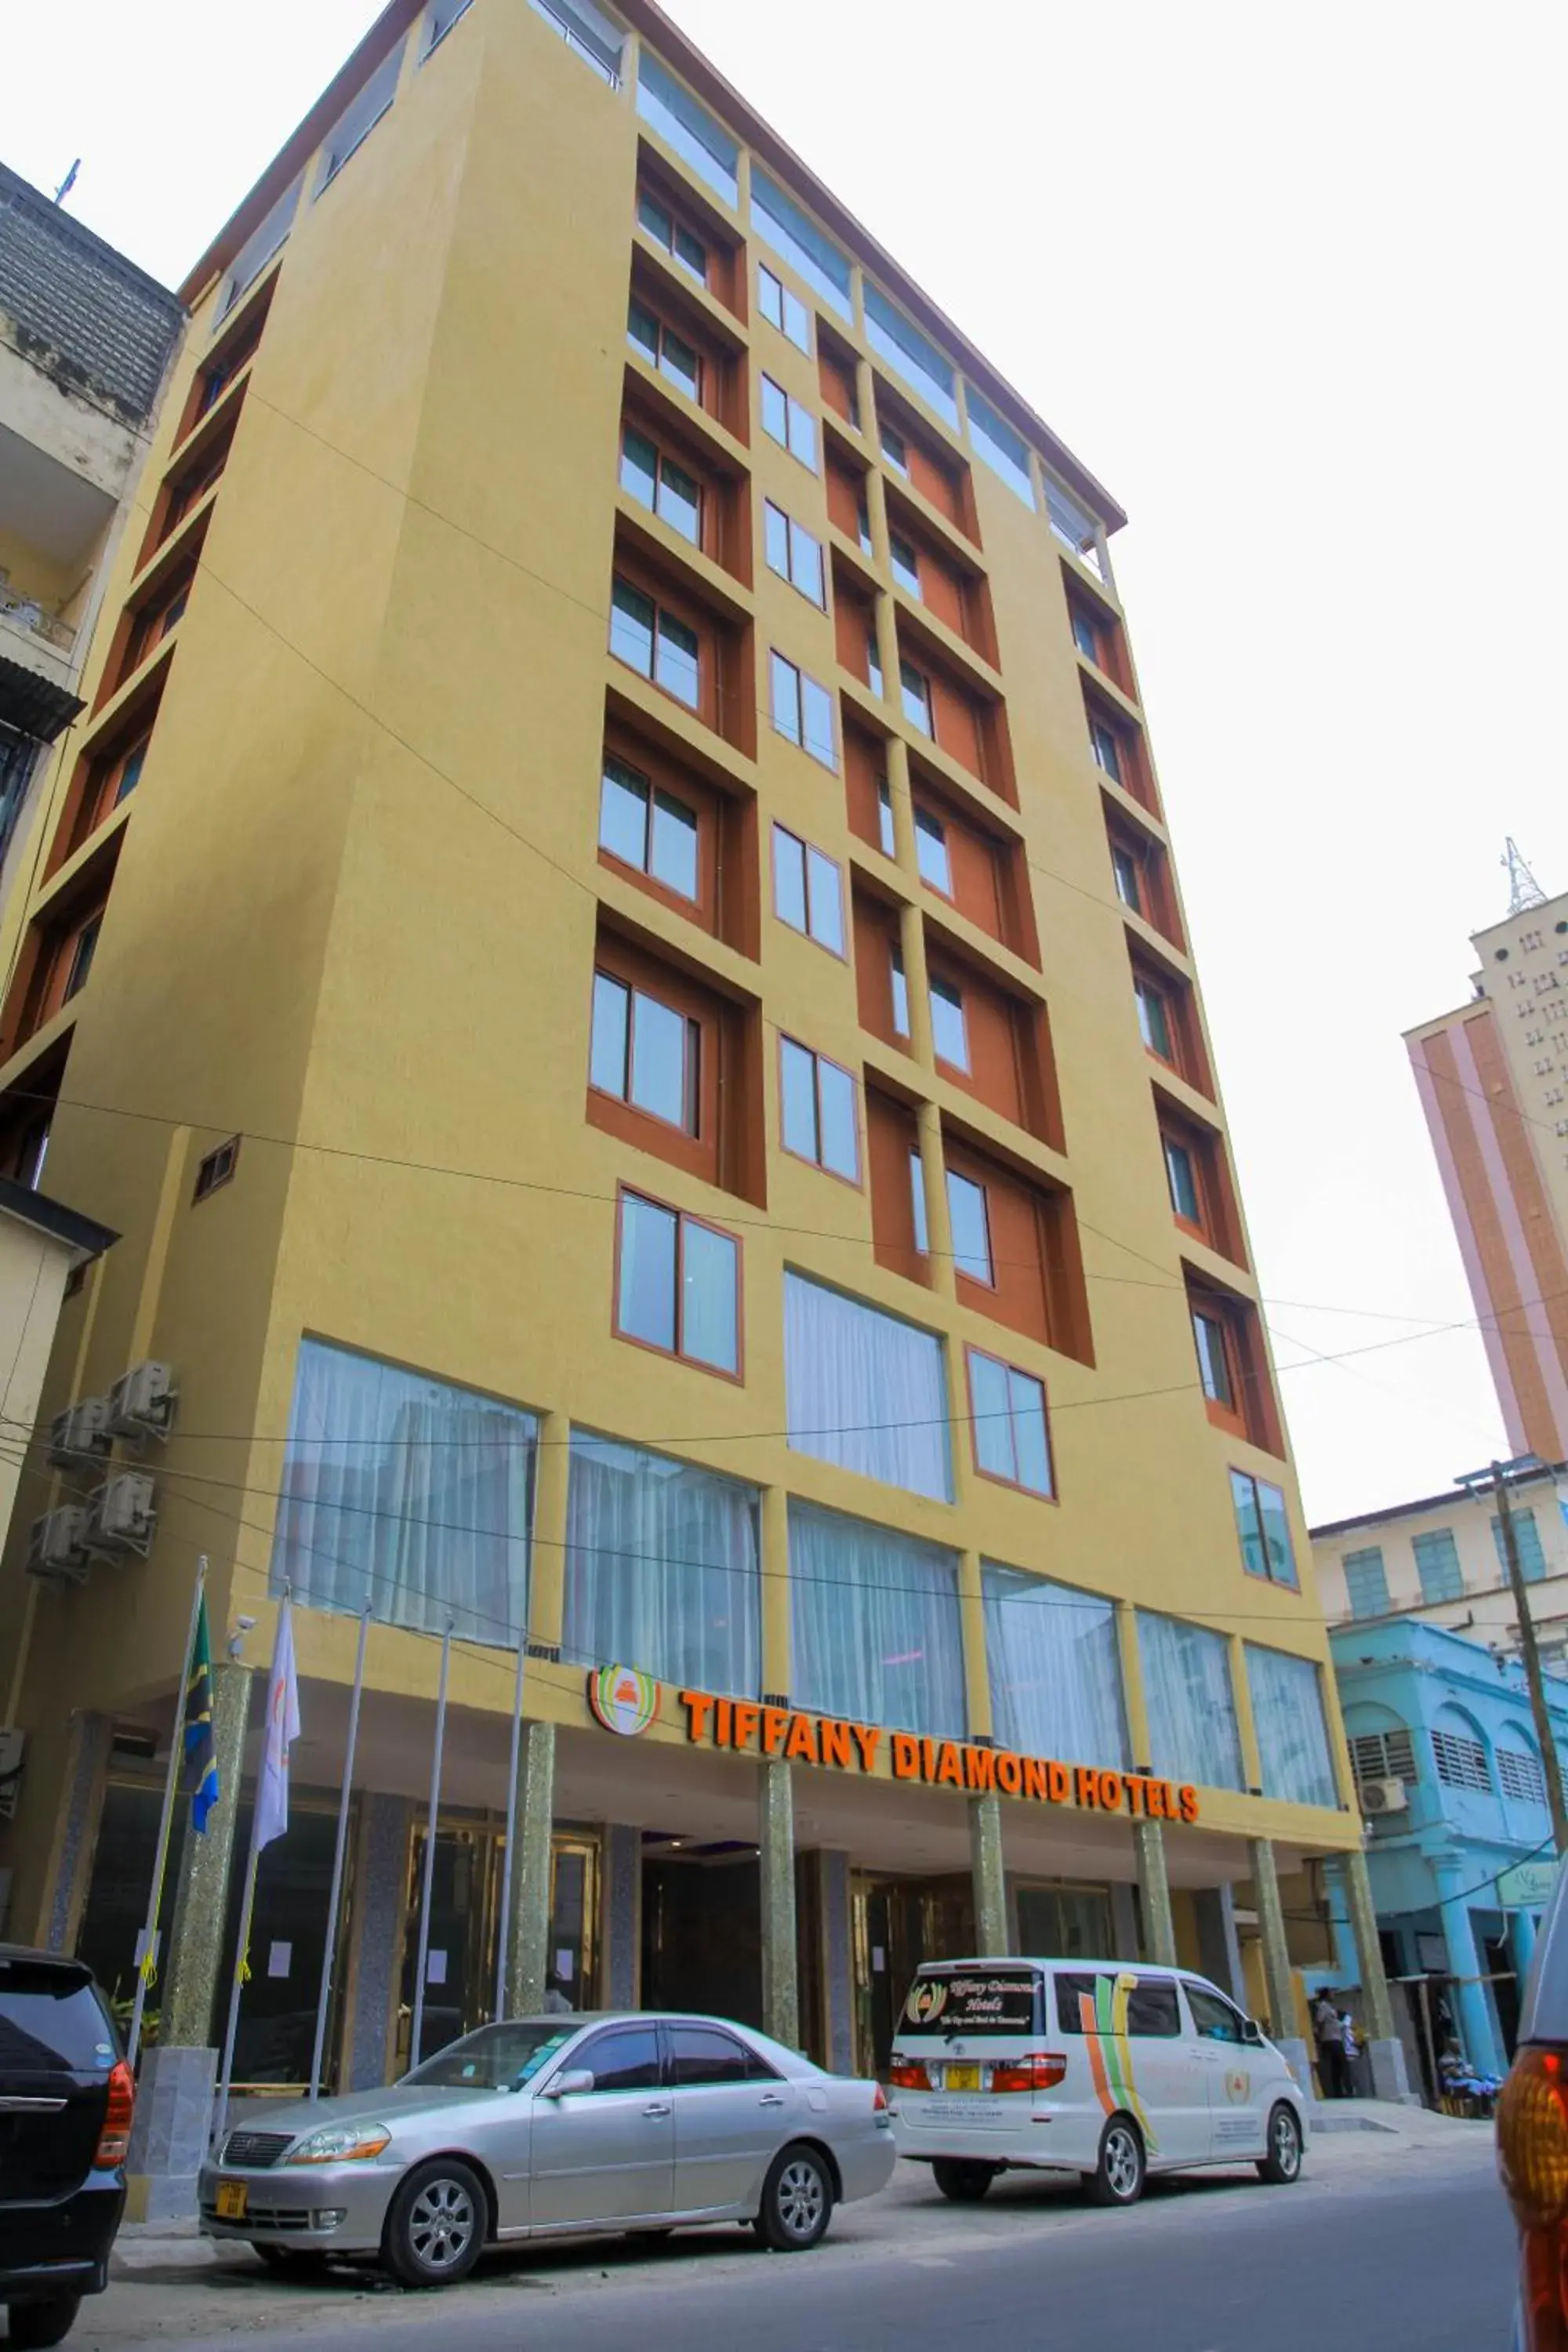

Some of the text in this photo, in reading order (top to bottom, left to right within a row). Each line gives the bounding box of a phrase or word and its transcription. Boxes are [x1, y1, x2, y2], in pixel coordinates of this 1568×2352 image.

[681, 1690, 1200, 1822] TIFFANY DIAMOND HOTELS
[950, 1980, 986, 1997] Tiffany
[966, 1997, 1002, 2012] Hotels
